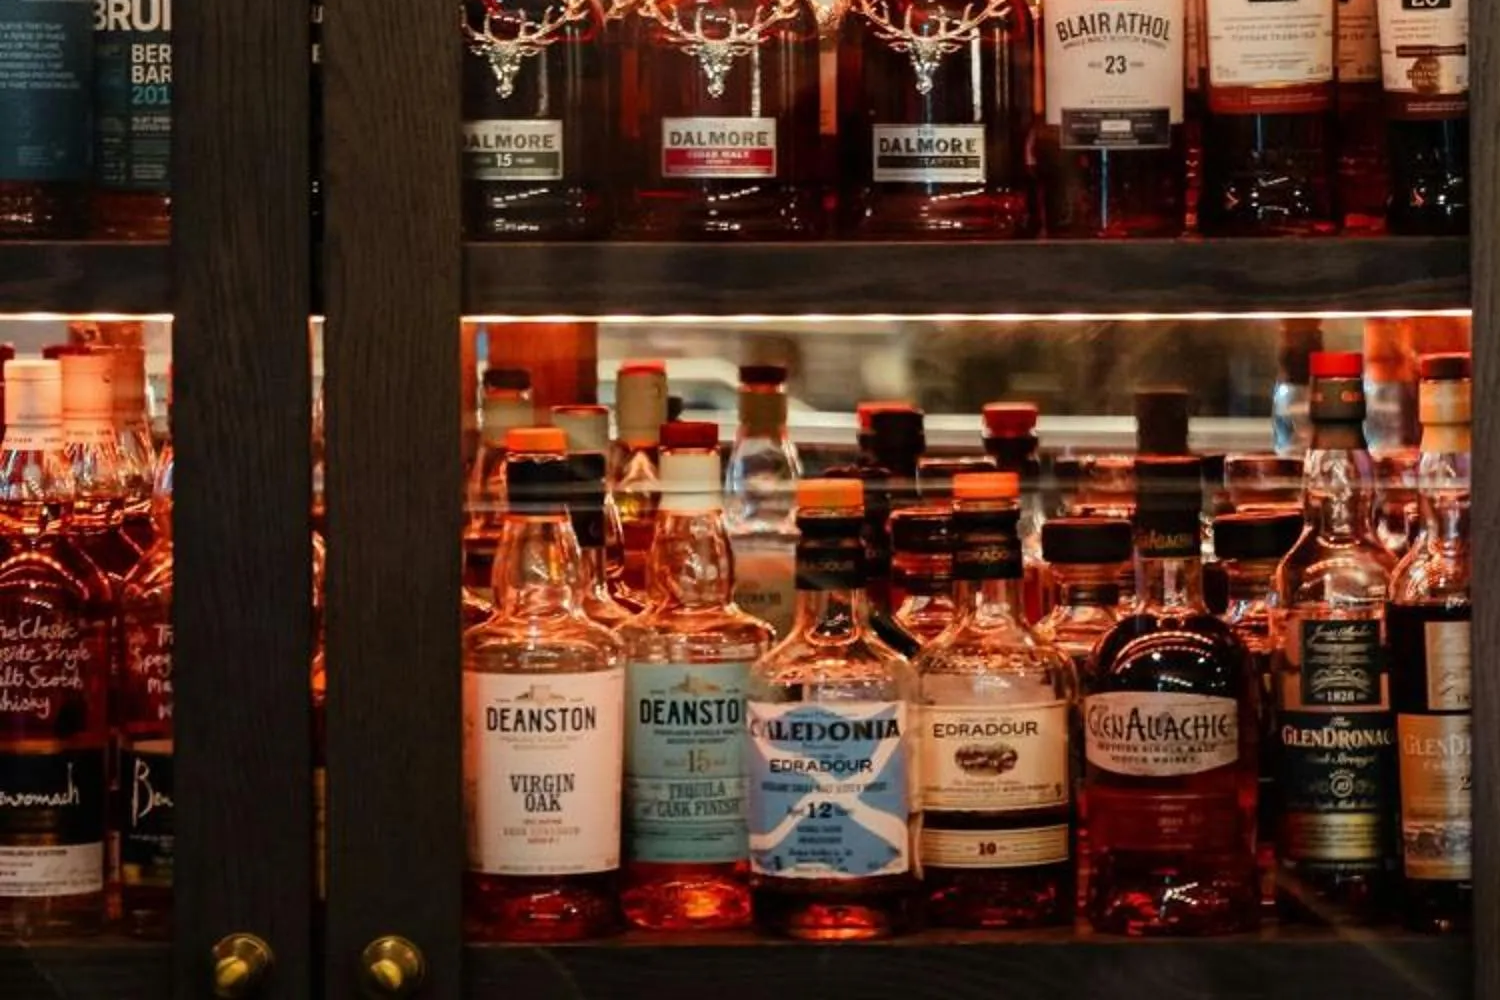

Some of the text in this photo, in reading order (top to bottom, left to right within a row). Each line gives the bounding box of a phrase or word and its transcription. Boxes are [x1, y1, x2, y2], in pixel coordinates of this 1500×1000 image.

[1055, 11, 1170, 42] BLAIR ATHOL
[1105, 54, 1128, 75] 23
[669, 131, 769, 147] DALMORE
[879, 137, 977, 154] DALMORE
[496, 152, 513, 168] 15
[486, 706, 597, 733] DEANSTON
[750, 718, 901, 742] CALEDONIA
[932, 721, 1039, 739] EDRADOUR
[769, 759, 874, 774] EDRADOUR
[509, 773, 576, 794] VIRGIN
[669, 780, 726, 799] TEQUILA
[525, 793, 562, 813] OAK
[657, 801, 694, 817] CASK
[807, 801, 833, 819] 12
[978, 842, 997, 856] 10
